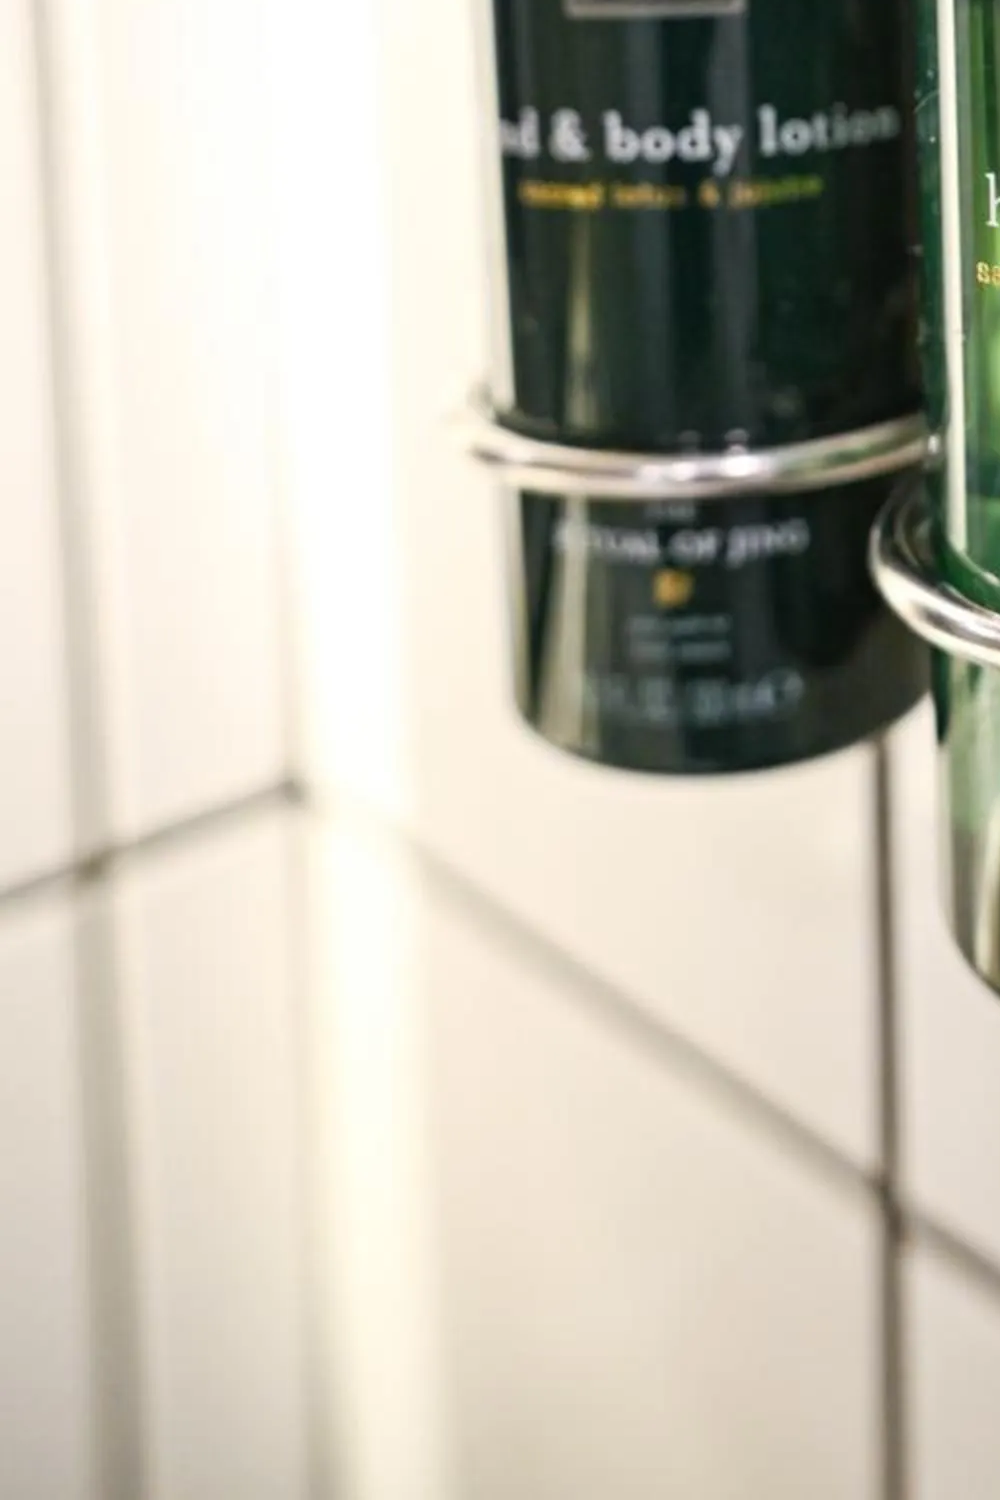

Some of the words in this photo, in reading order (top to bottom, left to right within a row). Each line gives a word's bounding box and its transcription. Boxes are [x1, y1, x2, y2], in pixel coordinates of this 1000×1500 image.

[548, 106, 592, 164] &
[602, 107, 745, 177] body
[757, 102, 899, 159] lotion
